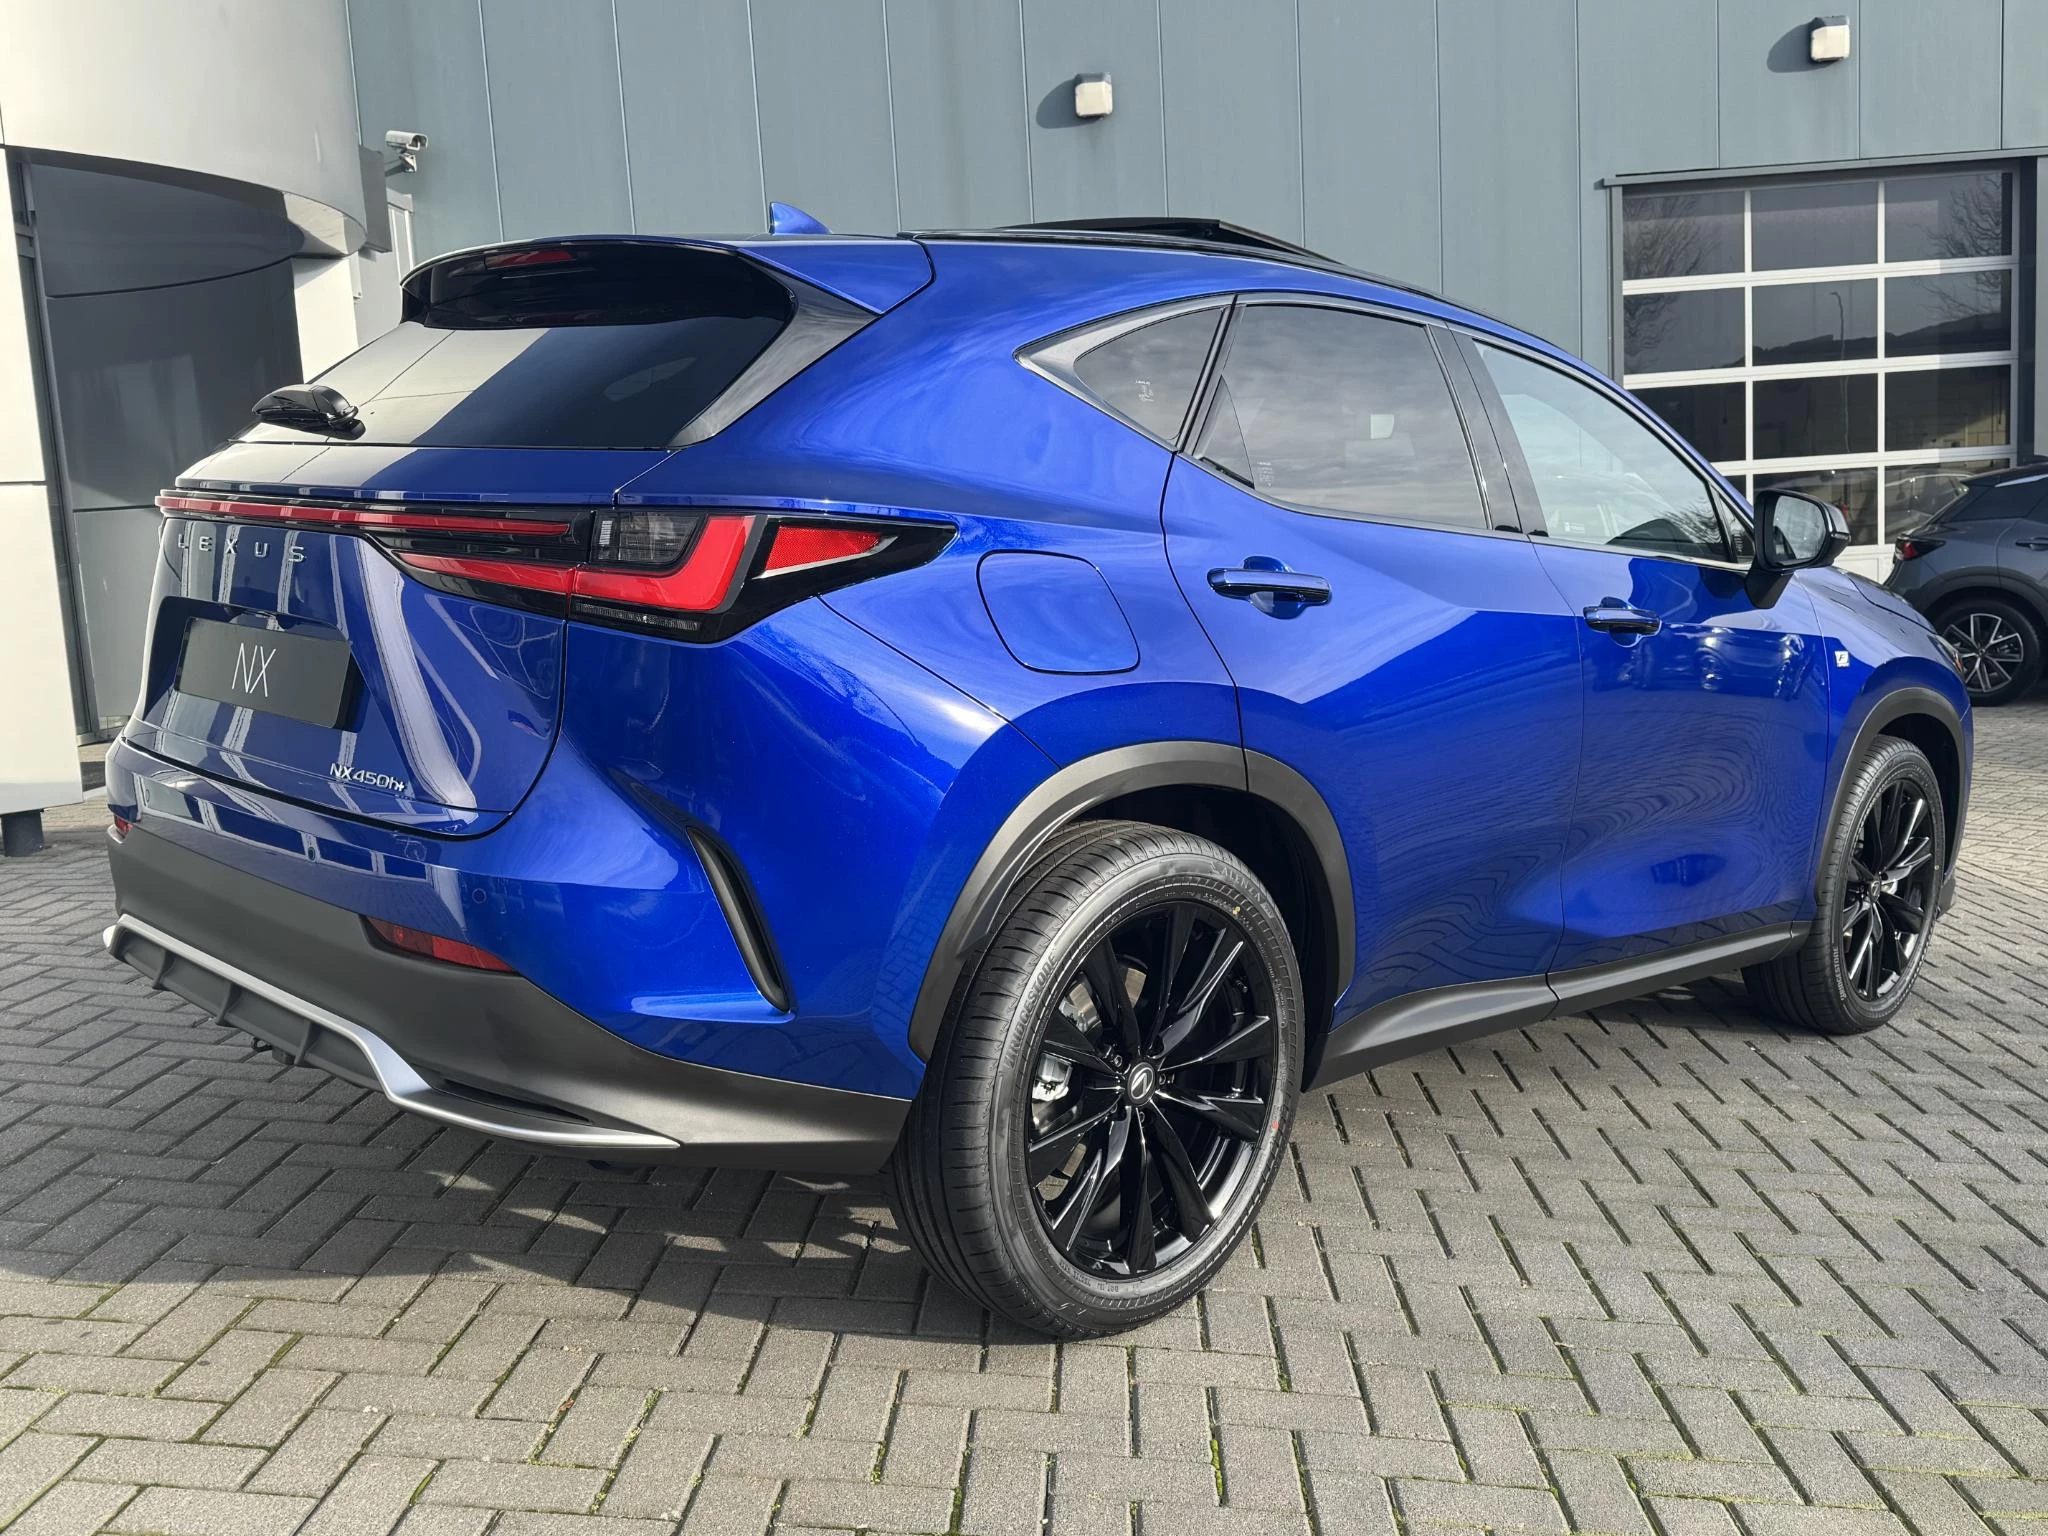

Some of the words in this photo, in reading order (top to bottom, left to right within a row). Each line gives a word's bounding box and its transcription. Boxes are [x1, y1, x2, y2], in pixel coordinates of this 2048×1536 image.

[178, 533, 307, 563] LEXUS
[232, 643, 277, 698] NX
[329, 762, 406, 793] NX450h+
[1002, 953, 1058, 1069] BRIDGESTONE
